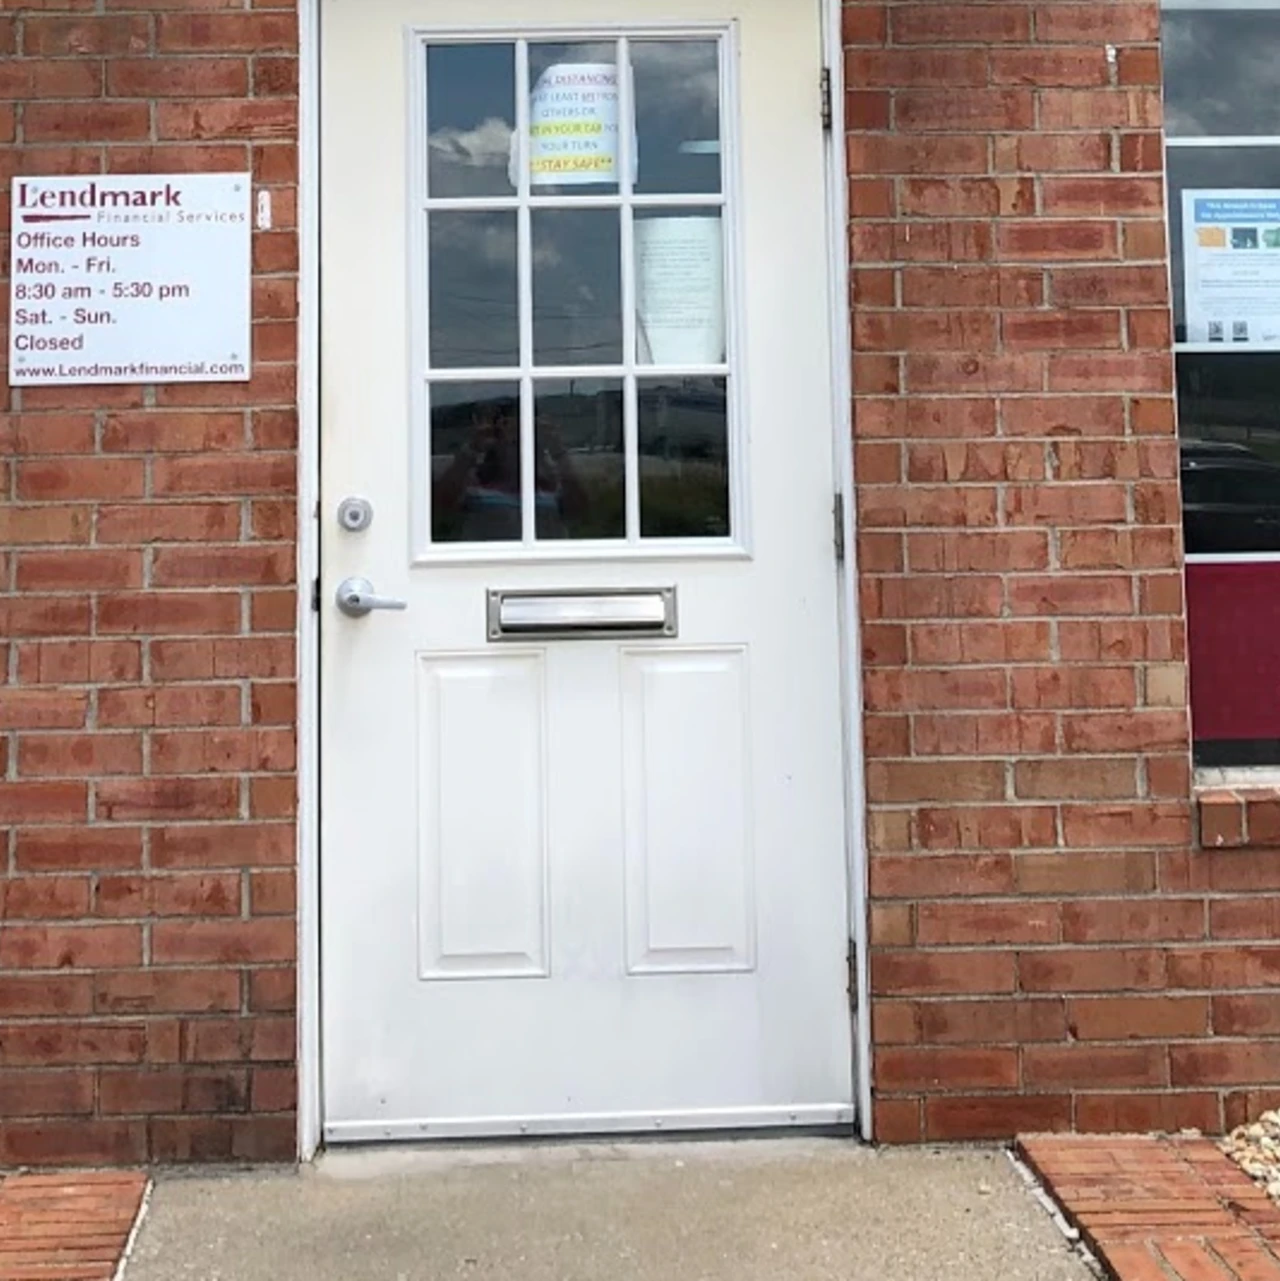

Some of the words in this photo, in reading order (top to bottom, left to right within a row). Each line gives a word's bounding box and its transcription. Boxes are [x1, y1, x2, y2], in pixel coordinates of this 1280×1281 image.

[17, 182, 183, 209] Lendmark
[96, 211, 170, 224] Financial
[176, 209, 246, 223] Services
[16, 231, 75, 249] Office
[82, 231, 141, 248] Hours
[16, 257, 65, 274] Mon.
[85, 256, 116, 274] Fri.
[15, 282, 56, 300] 8:30
[61, 287, 91, 300] am
[112, 282, 153, 299] 5:30
[158, 286, 190, 301] pm
[15, 308, 53, 326] Sat.
[73, 307, 117, 325] Sun.
[14, 333, 84, 351] Closed
[14, 361, 245, 378] www.Lendmarkfinancial.com
